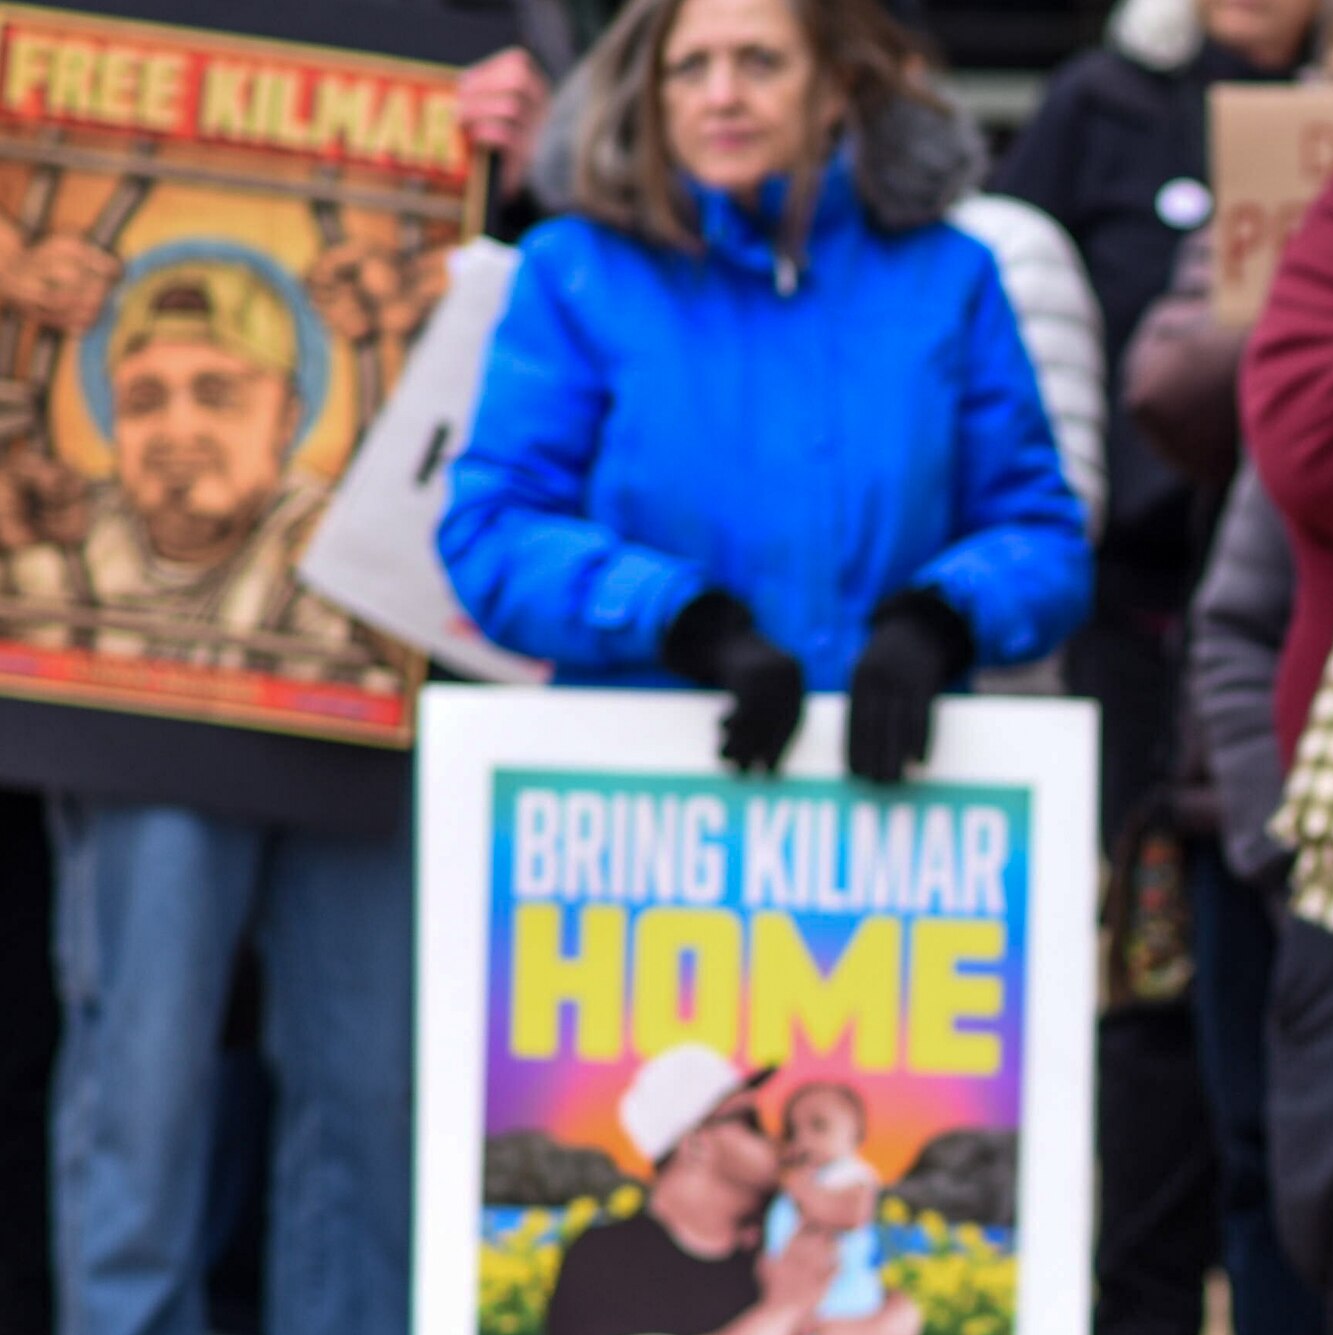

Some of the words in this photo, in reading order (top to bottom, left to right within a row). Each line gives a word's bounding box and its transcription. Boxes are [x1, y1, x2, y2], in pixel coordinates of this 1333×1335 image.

[5, 33, 184, 134] FREE
[514, 788, 729, 904] BRING
[743, 798, 1009, 913] KILMAR
[509, 902, 1006, 1076] HOME
